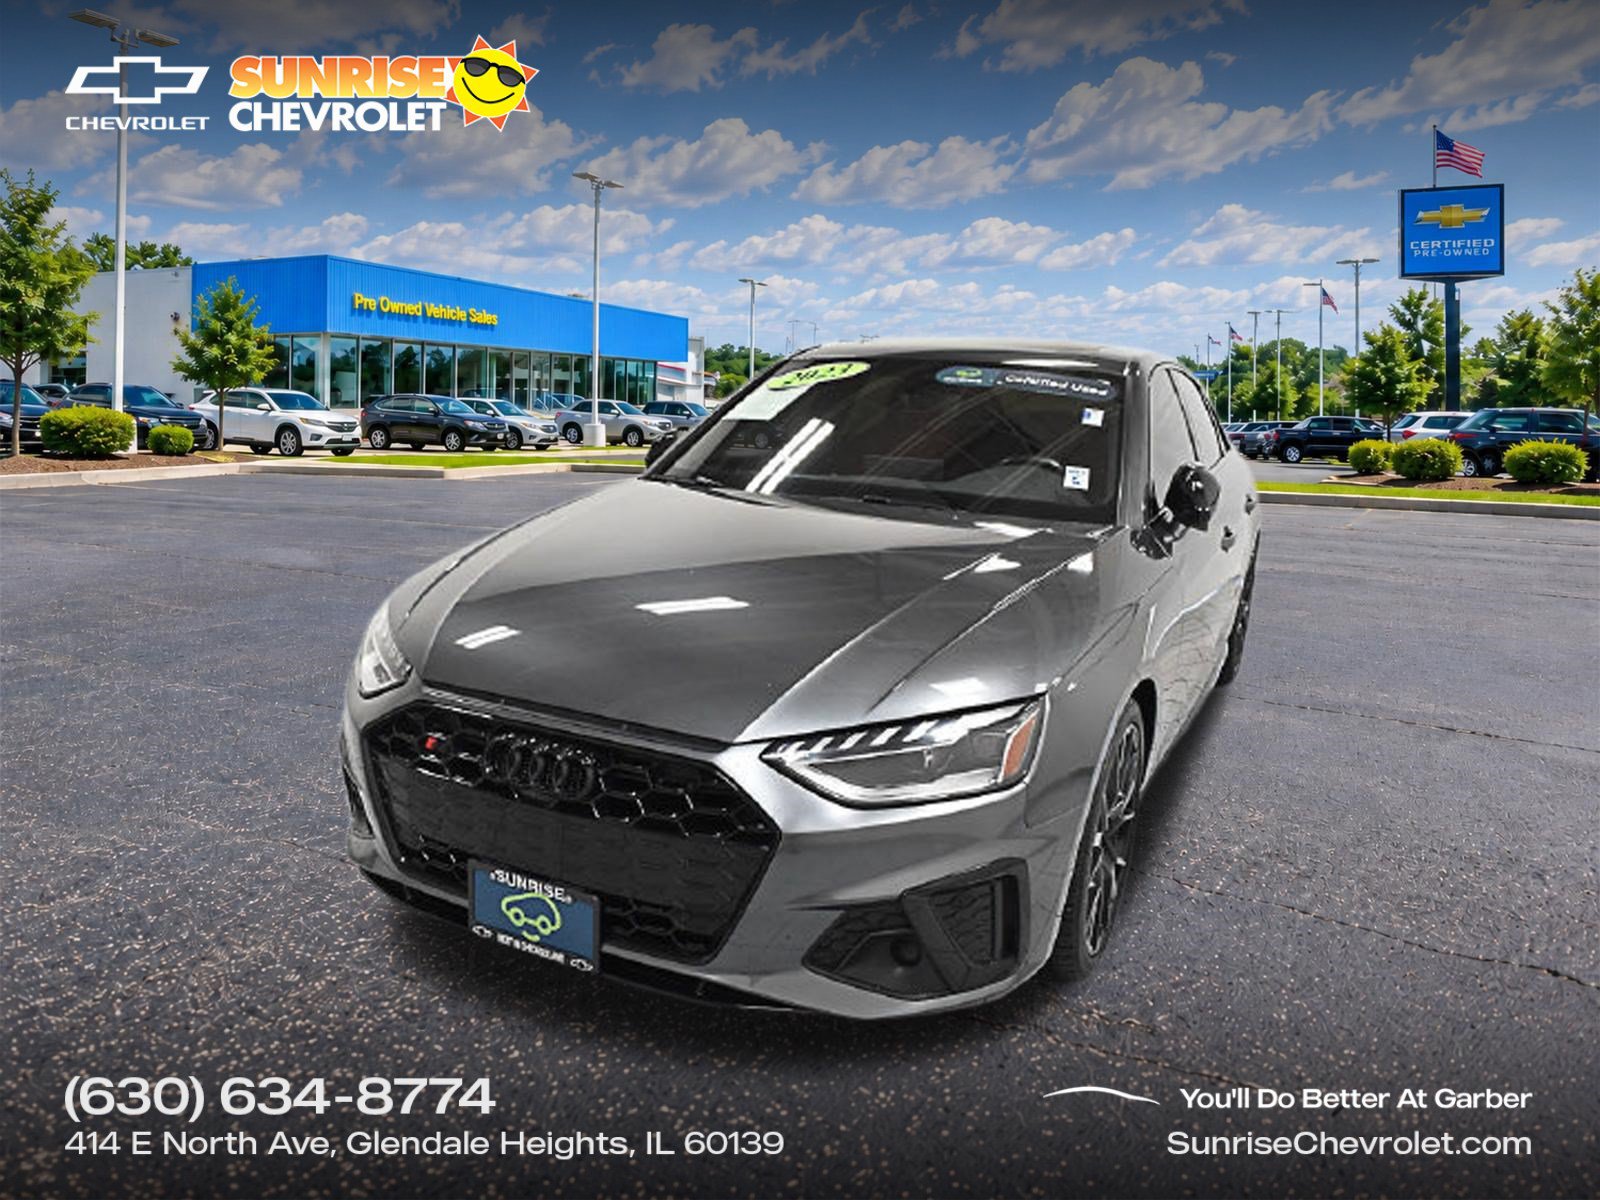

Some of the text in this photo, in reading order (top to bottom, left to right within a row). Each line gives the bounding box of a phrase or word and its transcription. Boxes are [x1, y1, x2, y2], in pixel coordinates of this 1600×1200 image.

[1410, 239, 1495, 250] CERTIFIED
[1413, 248, 1490, 258] PRE-OWNED
[354, 293, 498, 325] Pre Owned Vehicle Sales
[494, 869, 566, 902] SUNRISE
